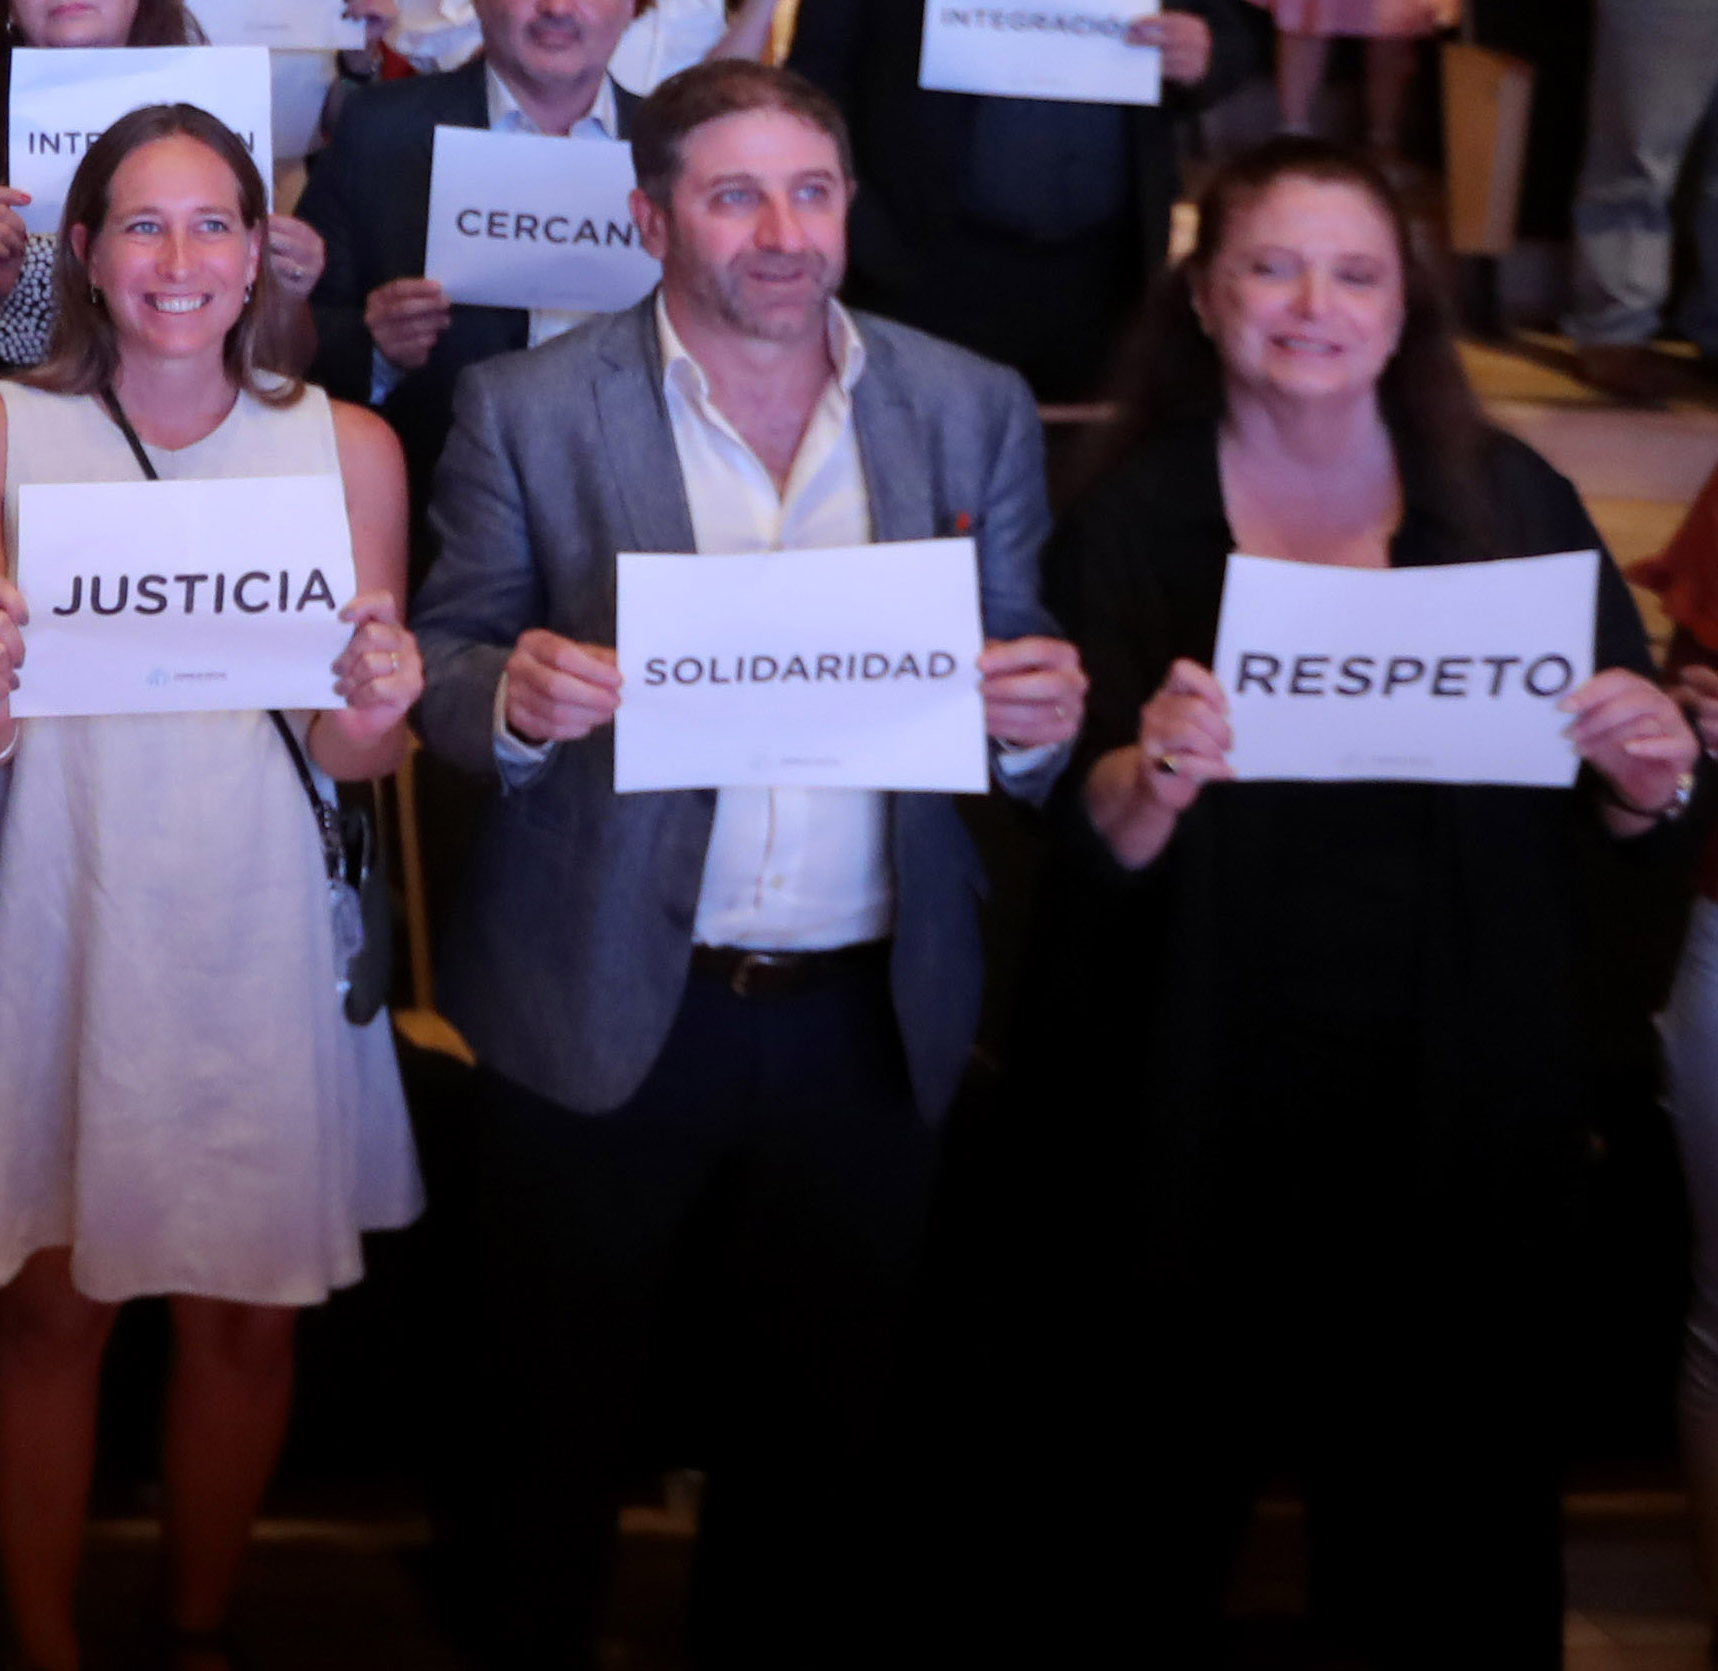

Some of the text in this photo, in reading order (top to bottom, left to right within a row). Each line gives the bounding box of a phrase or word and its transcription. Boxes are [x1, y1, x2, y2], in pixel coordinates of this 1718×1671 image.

[456, 207, 639, 246] CERCAN
[51, 566, 338, 620] JUSTICIA
[643, 649, 958, 688] SOLIDARIDAD
[1236, 651, 1574, 700] RESPETO
